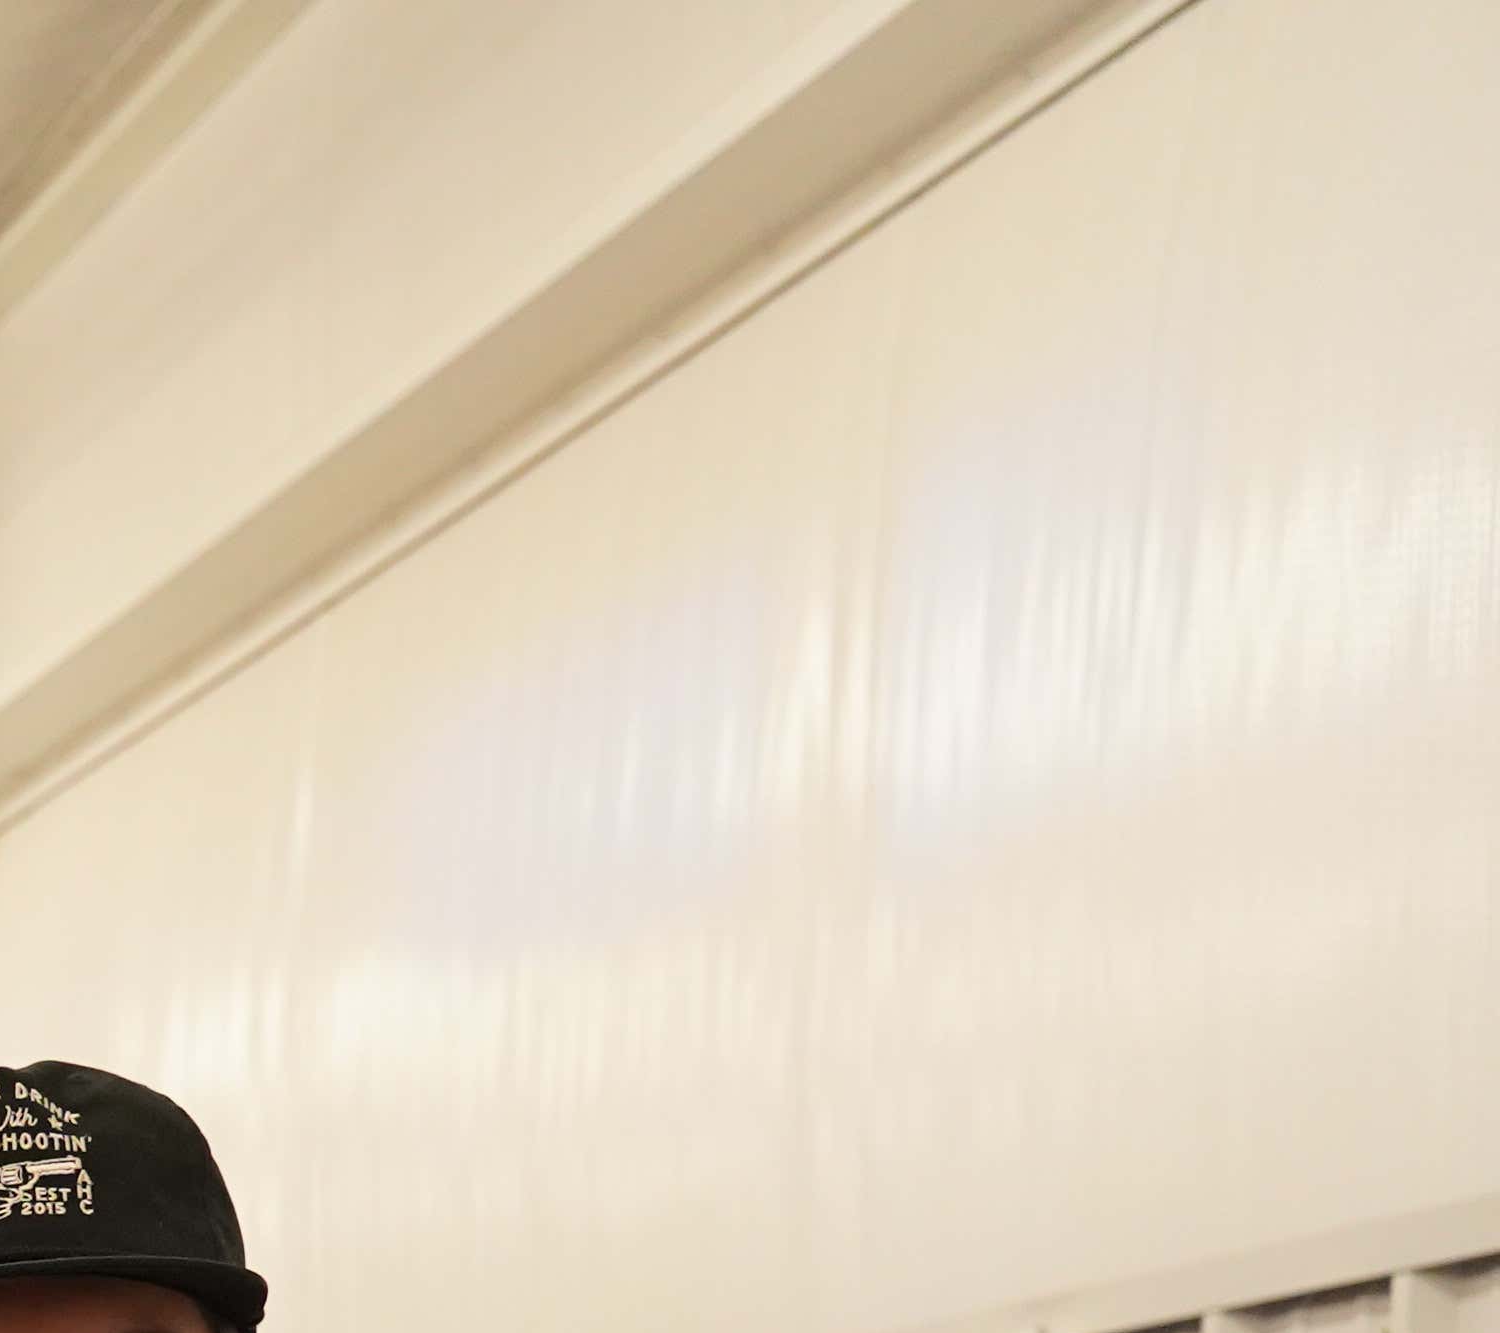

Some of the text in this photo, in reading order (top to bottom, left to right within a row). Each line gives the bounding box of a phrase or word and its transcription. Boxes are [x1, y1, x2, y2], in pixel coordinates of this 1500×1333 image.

[14, 1081, 81, 1126] DRINK
[33, 1187, 72, 1202] EST
[20, 1201, 67, 1216] 2015
